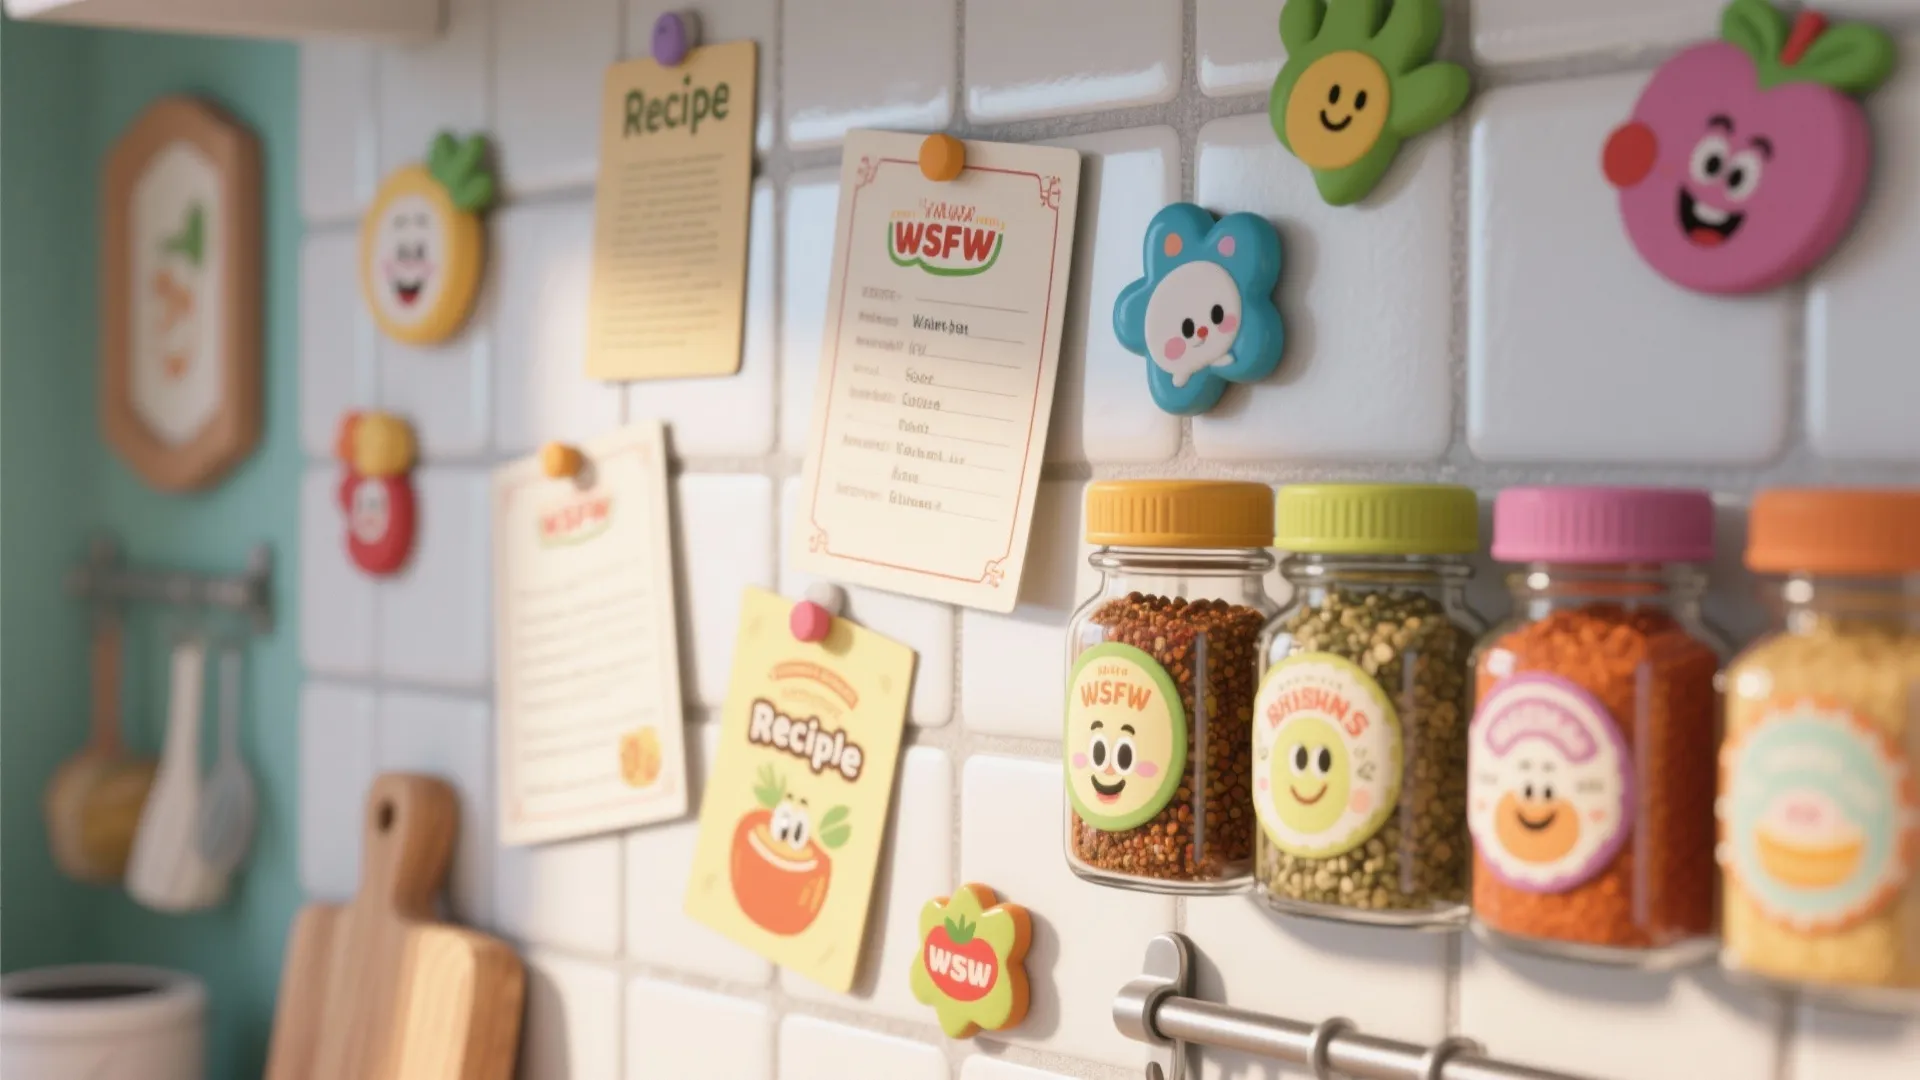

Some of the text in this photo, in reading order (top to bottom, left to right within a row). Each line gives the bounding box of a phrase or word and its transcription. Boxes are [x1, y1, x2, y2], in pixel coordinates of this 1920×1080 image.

[624, 73, 729, 136] Recipe
[895, 221, 996, 262] WSFW
[1080, 679, 1152, 712] WSFW
[749, 697, 864, 782] Reciple
[929, 943, 992, 988] WSW
